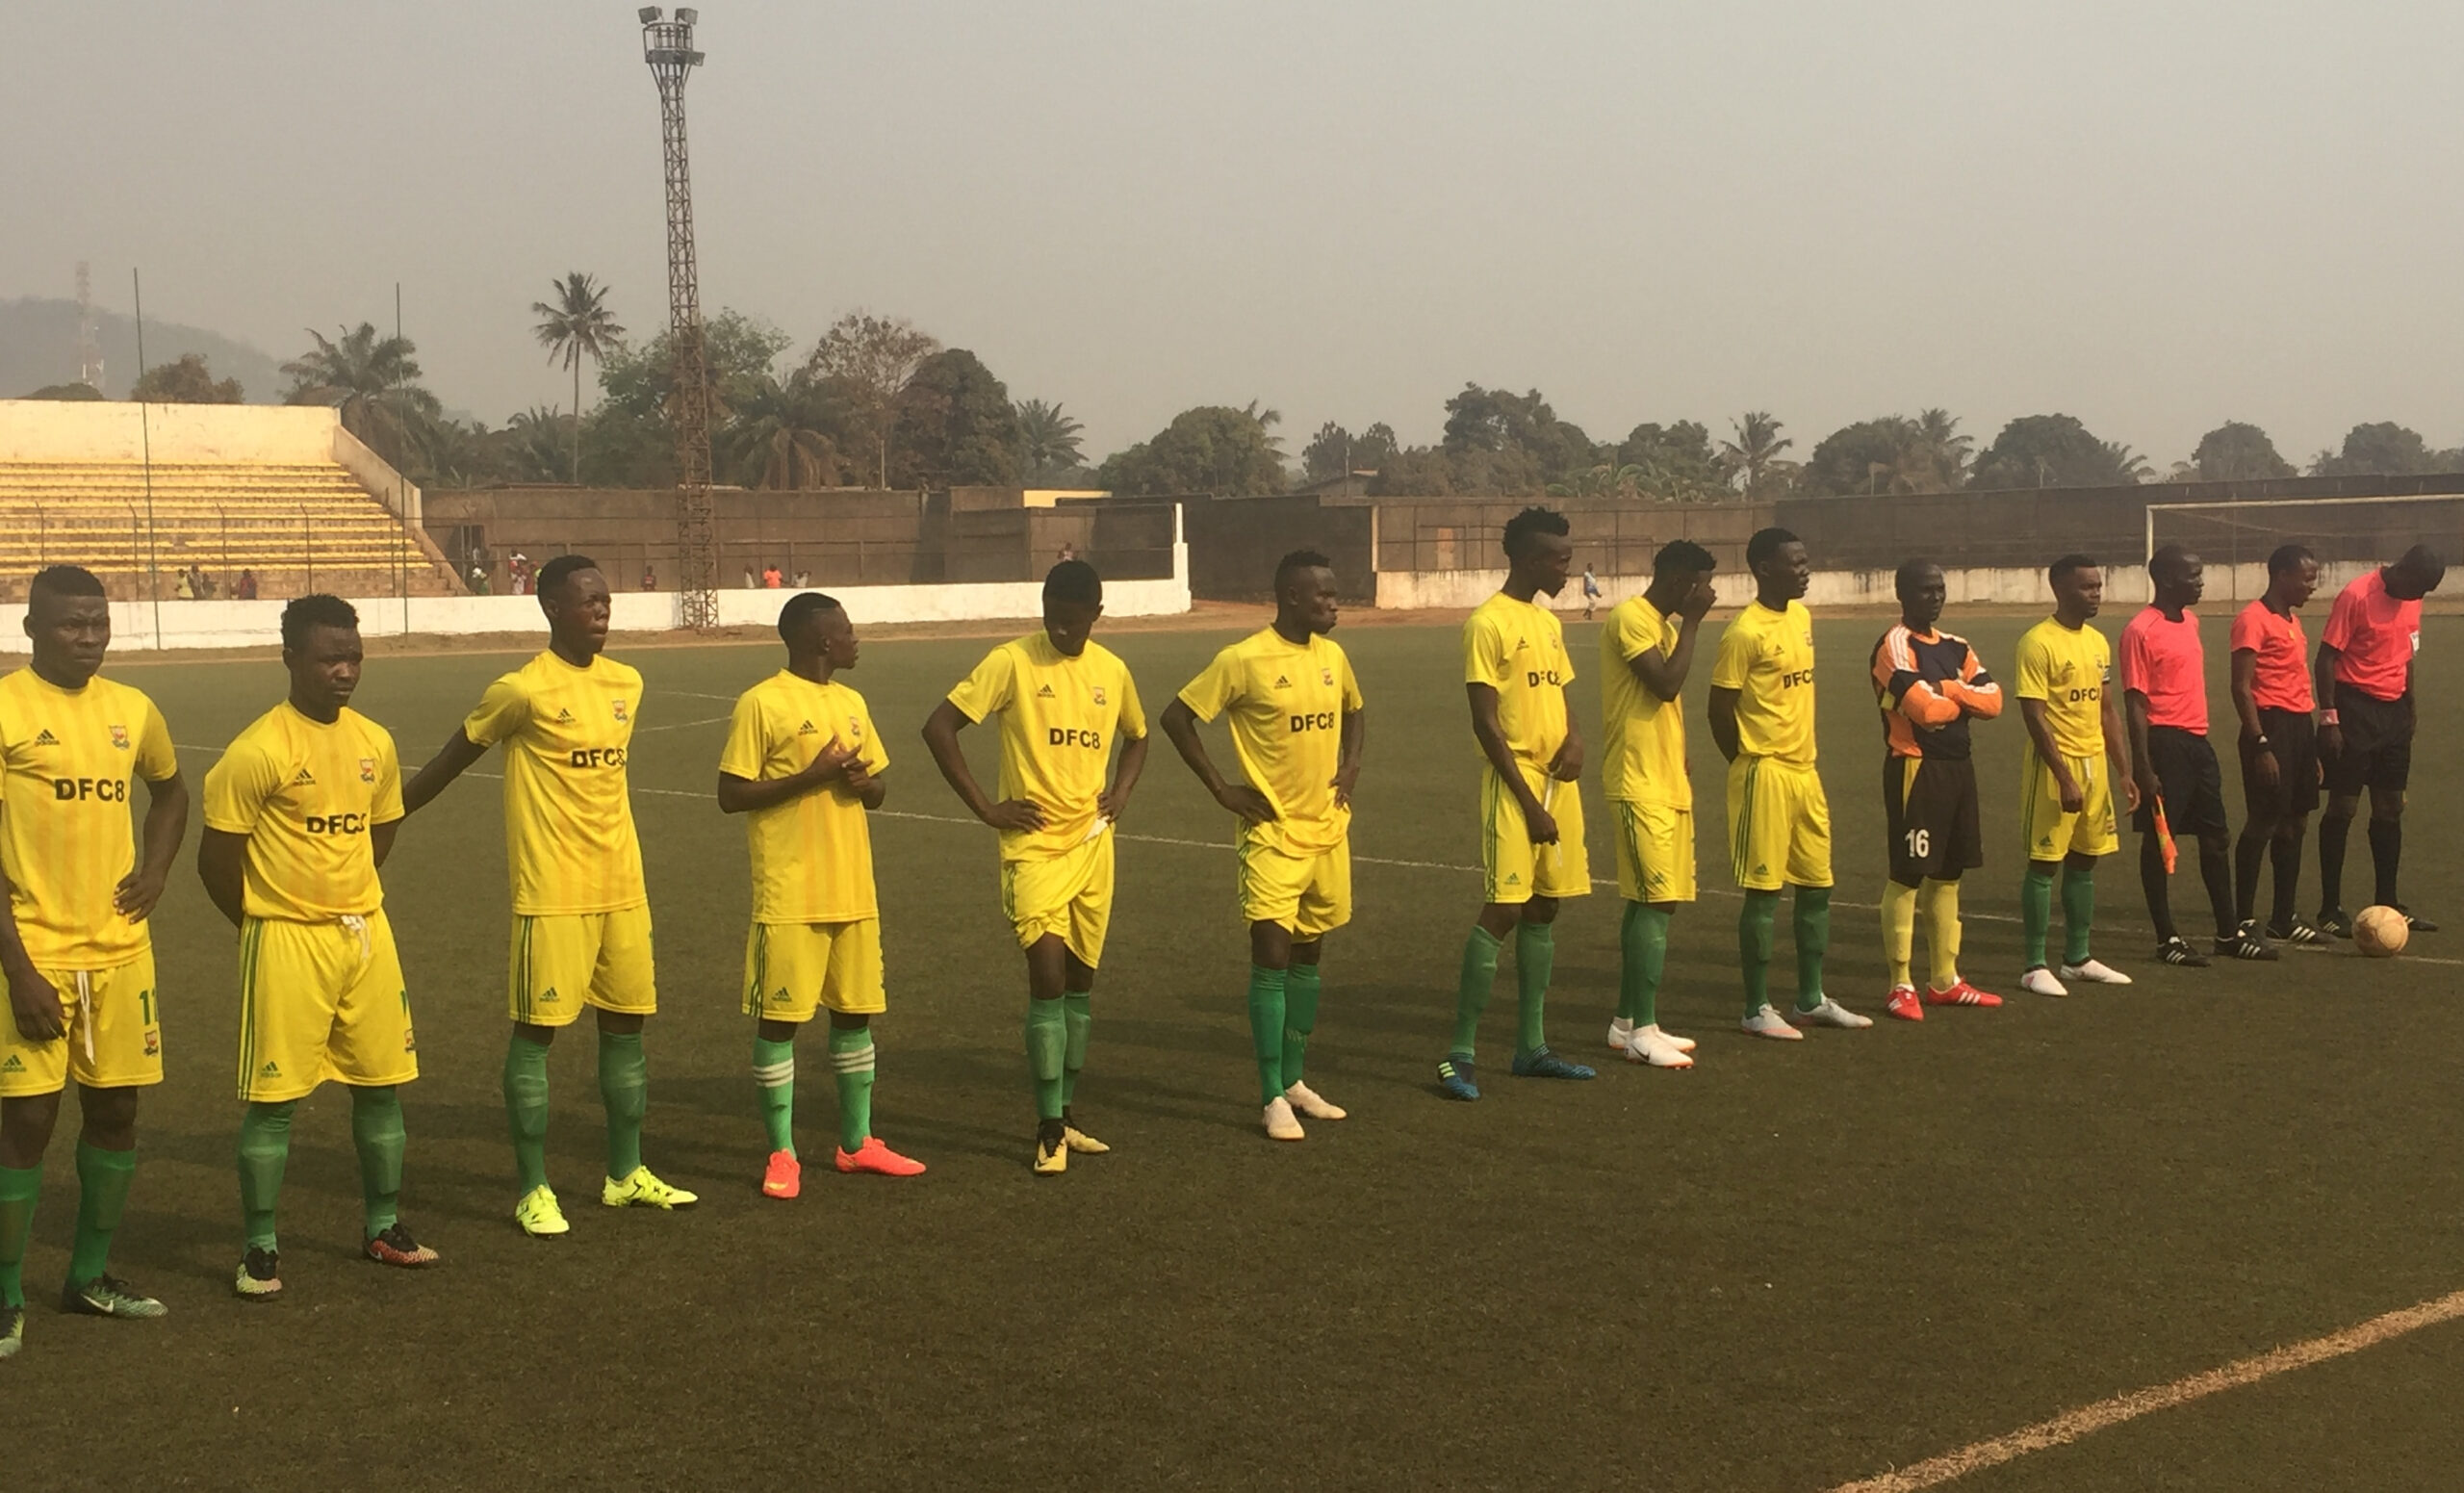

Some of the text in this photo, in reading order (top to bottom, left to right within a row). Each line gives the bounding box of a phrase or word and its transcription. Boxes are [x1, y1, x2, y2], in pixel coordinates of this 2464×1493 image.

[1784, 668, 1814, 689] DFC
[1291, 712, 1334, 733] DFC8
[1049, 728, 1100, 750] DFC8
[571, 748, 625, 768] DFC8
[55, 778, 125, 803] DFC8
[1905, 829, 1930, 858] 16
